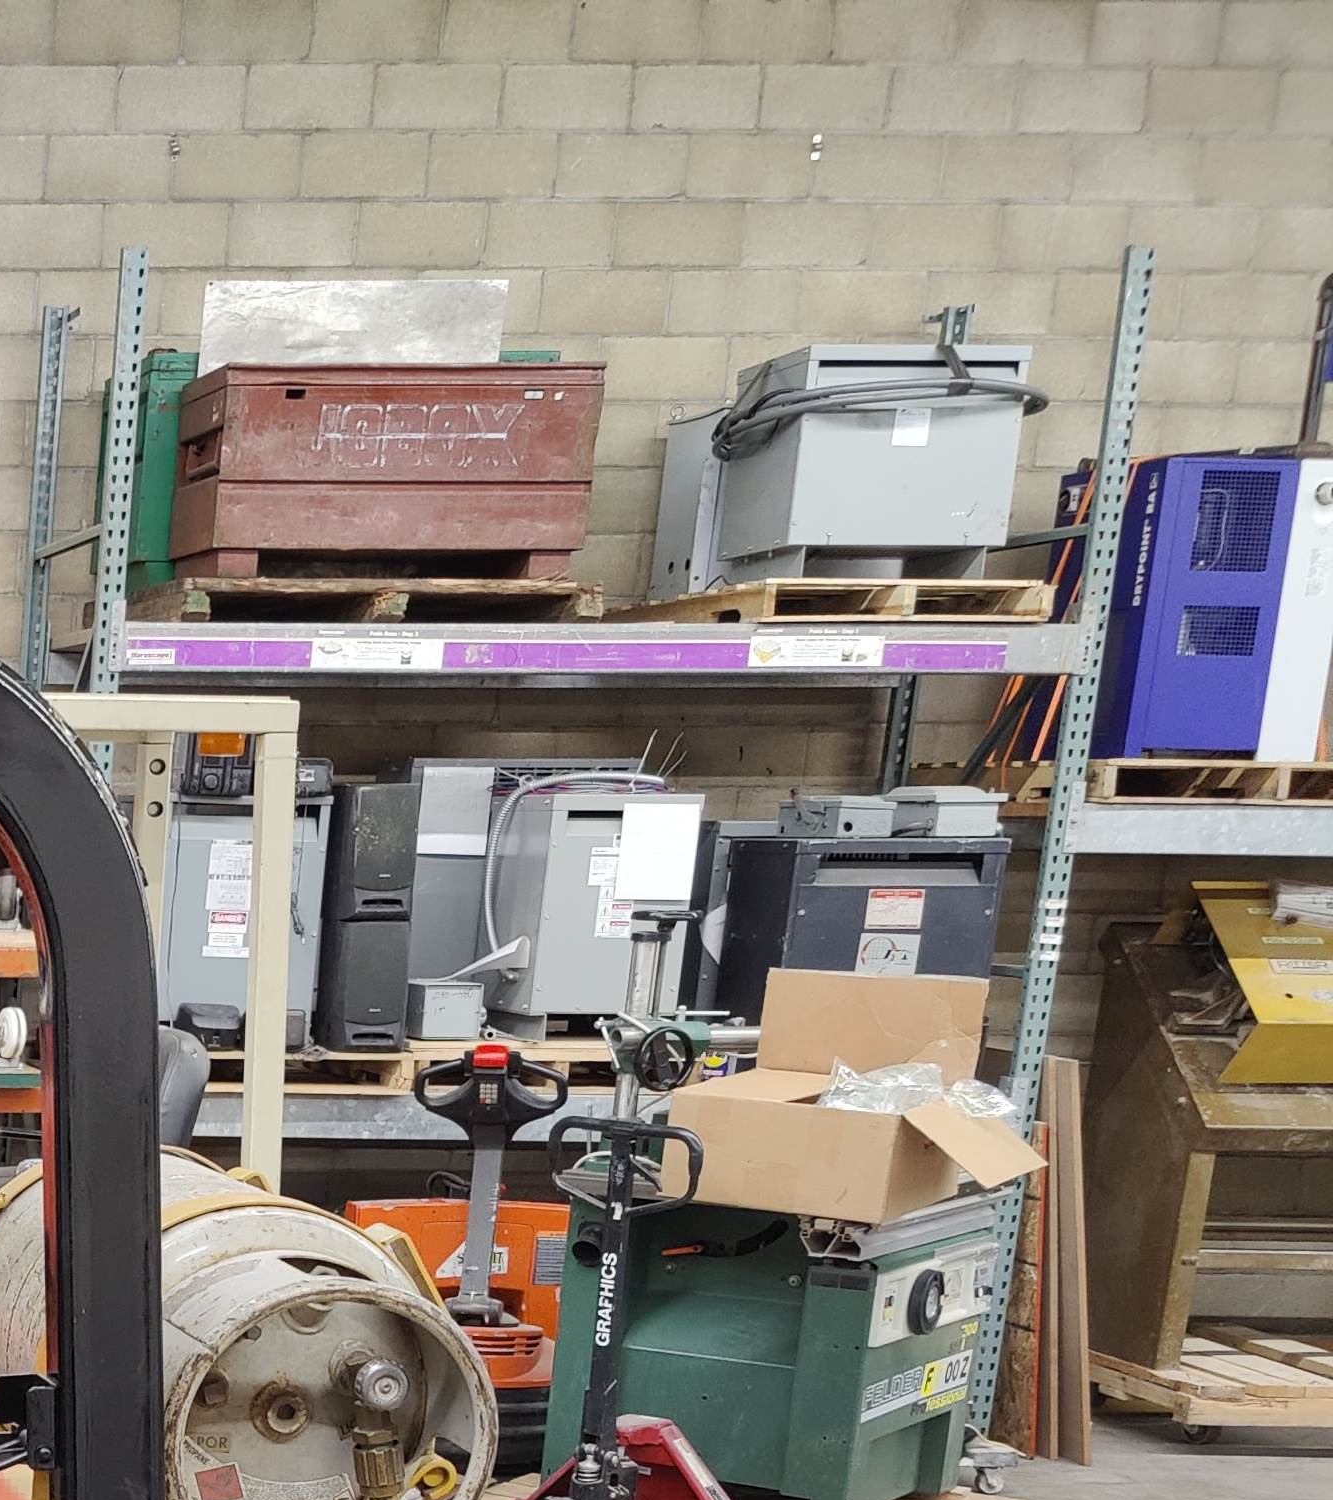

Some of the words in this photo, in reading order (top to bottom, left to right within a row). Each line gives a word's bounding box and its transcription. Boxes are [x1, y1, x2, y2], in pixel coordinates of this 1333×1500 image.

[861, 1366, 924, 1411] FELDER
[183, 1441, 211, 1466] PROPANE
[197, 1436, 228, 1449] POR
